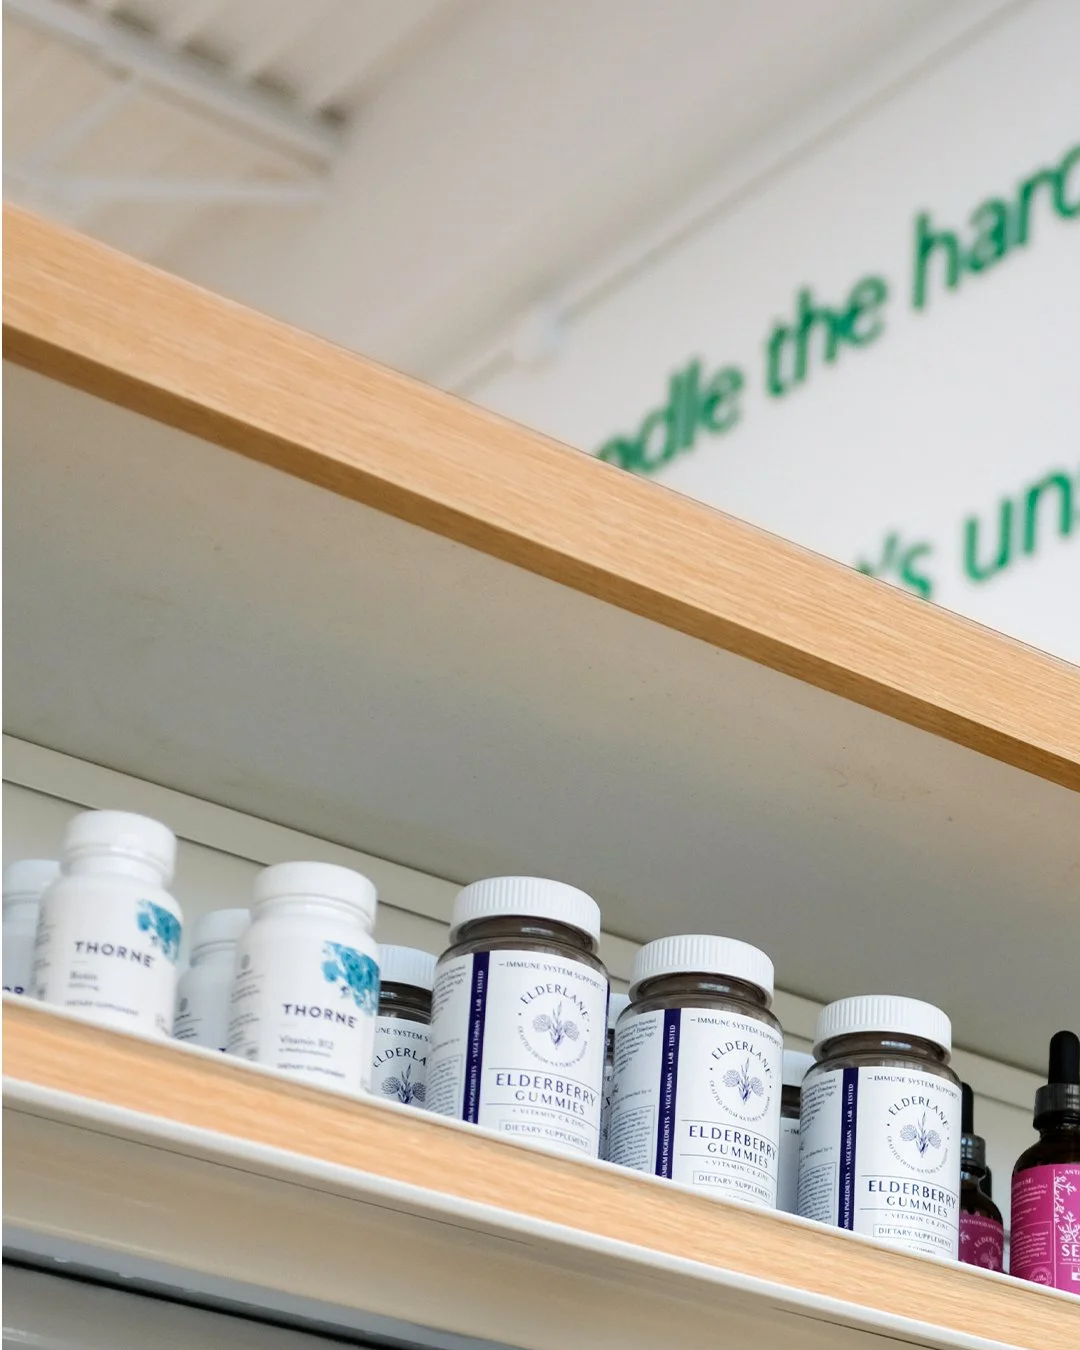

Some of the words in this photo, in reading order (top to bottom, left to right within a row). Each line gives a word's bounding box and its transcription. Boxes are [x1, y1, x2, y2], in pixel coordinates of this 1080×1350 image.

[765, 276, 888, 401] the
[74, 941, 154, 968] THORNE
[506, 961, 540, 970] IMMUNE
[543, 964, 573, 977] SYSTEM
[520, 983, 589, 1020] ELDERLANE
[282, 1004, 357, 1028] THORNE
[697, 1017, 731, 1027] IMMUNE
[732, 1021, 758, 1034] SYSTEM
[393, 1029, 423, 1041] SYSTEM
[711, 1040, 772, 1076] ELDERLANE
[496, 1073, 596, 1107] ELDERBERRY
[874, 1075, 906, 1083] IMMUNE
[908, 1077, 934, 1089] SYSTEM
[515, 1090, 585, 1116] GUMMIES
[888, 1095, 949, 1128] ELDERLANE
[504, 1123, 541, 1133] DIETARY
[544, 1128, 588, 1148] SUPPLEMENT
[689, 1125, 776, 1160] ELDERBERRY
[707, 1142, 768, 1169] GUMMIES
[698, 1174, 732, 1185] DIETARY
[735, 1181, 771, 1199] SUPPLEMENT
[868, 1179, 956, 1208] ELDERBERRY
[886, 1196, 948, 1218] GUMMIES
[878, 1227, 912, 1237] DIETARY
[914, 1232, 951, 1248] SUPPLEMENT
